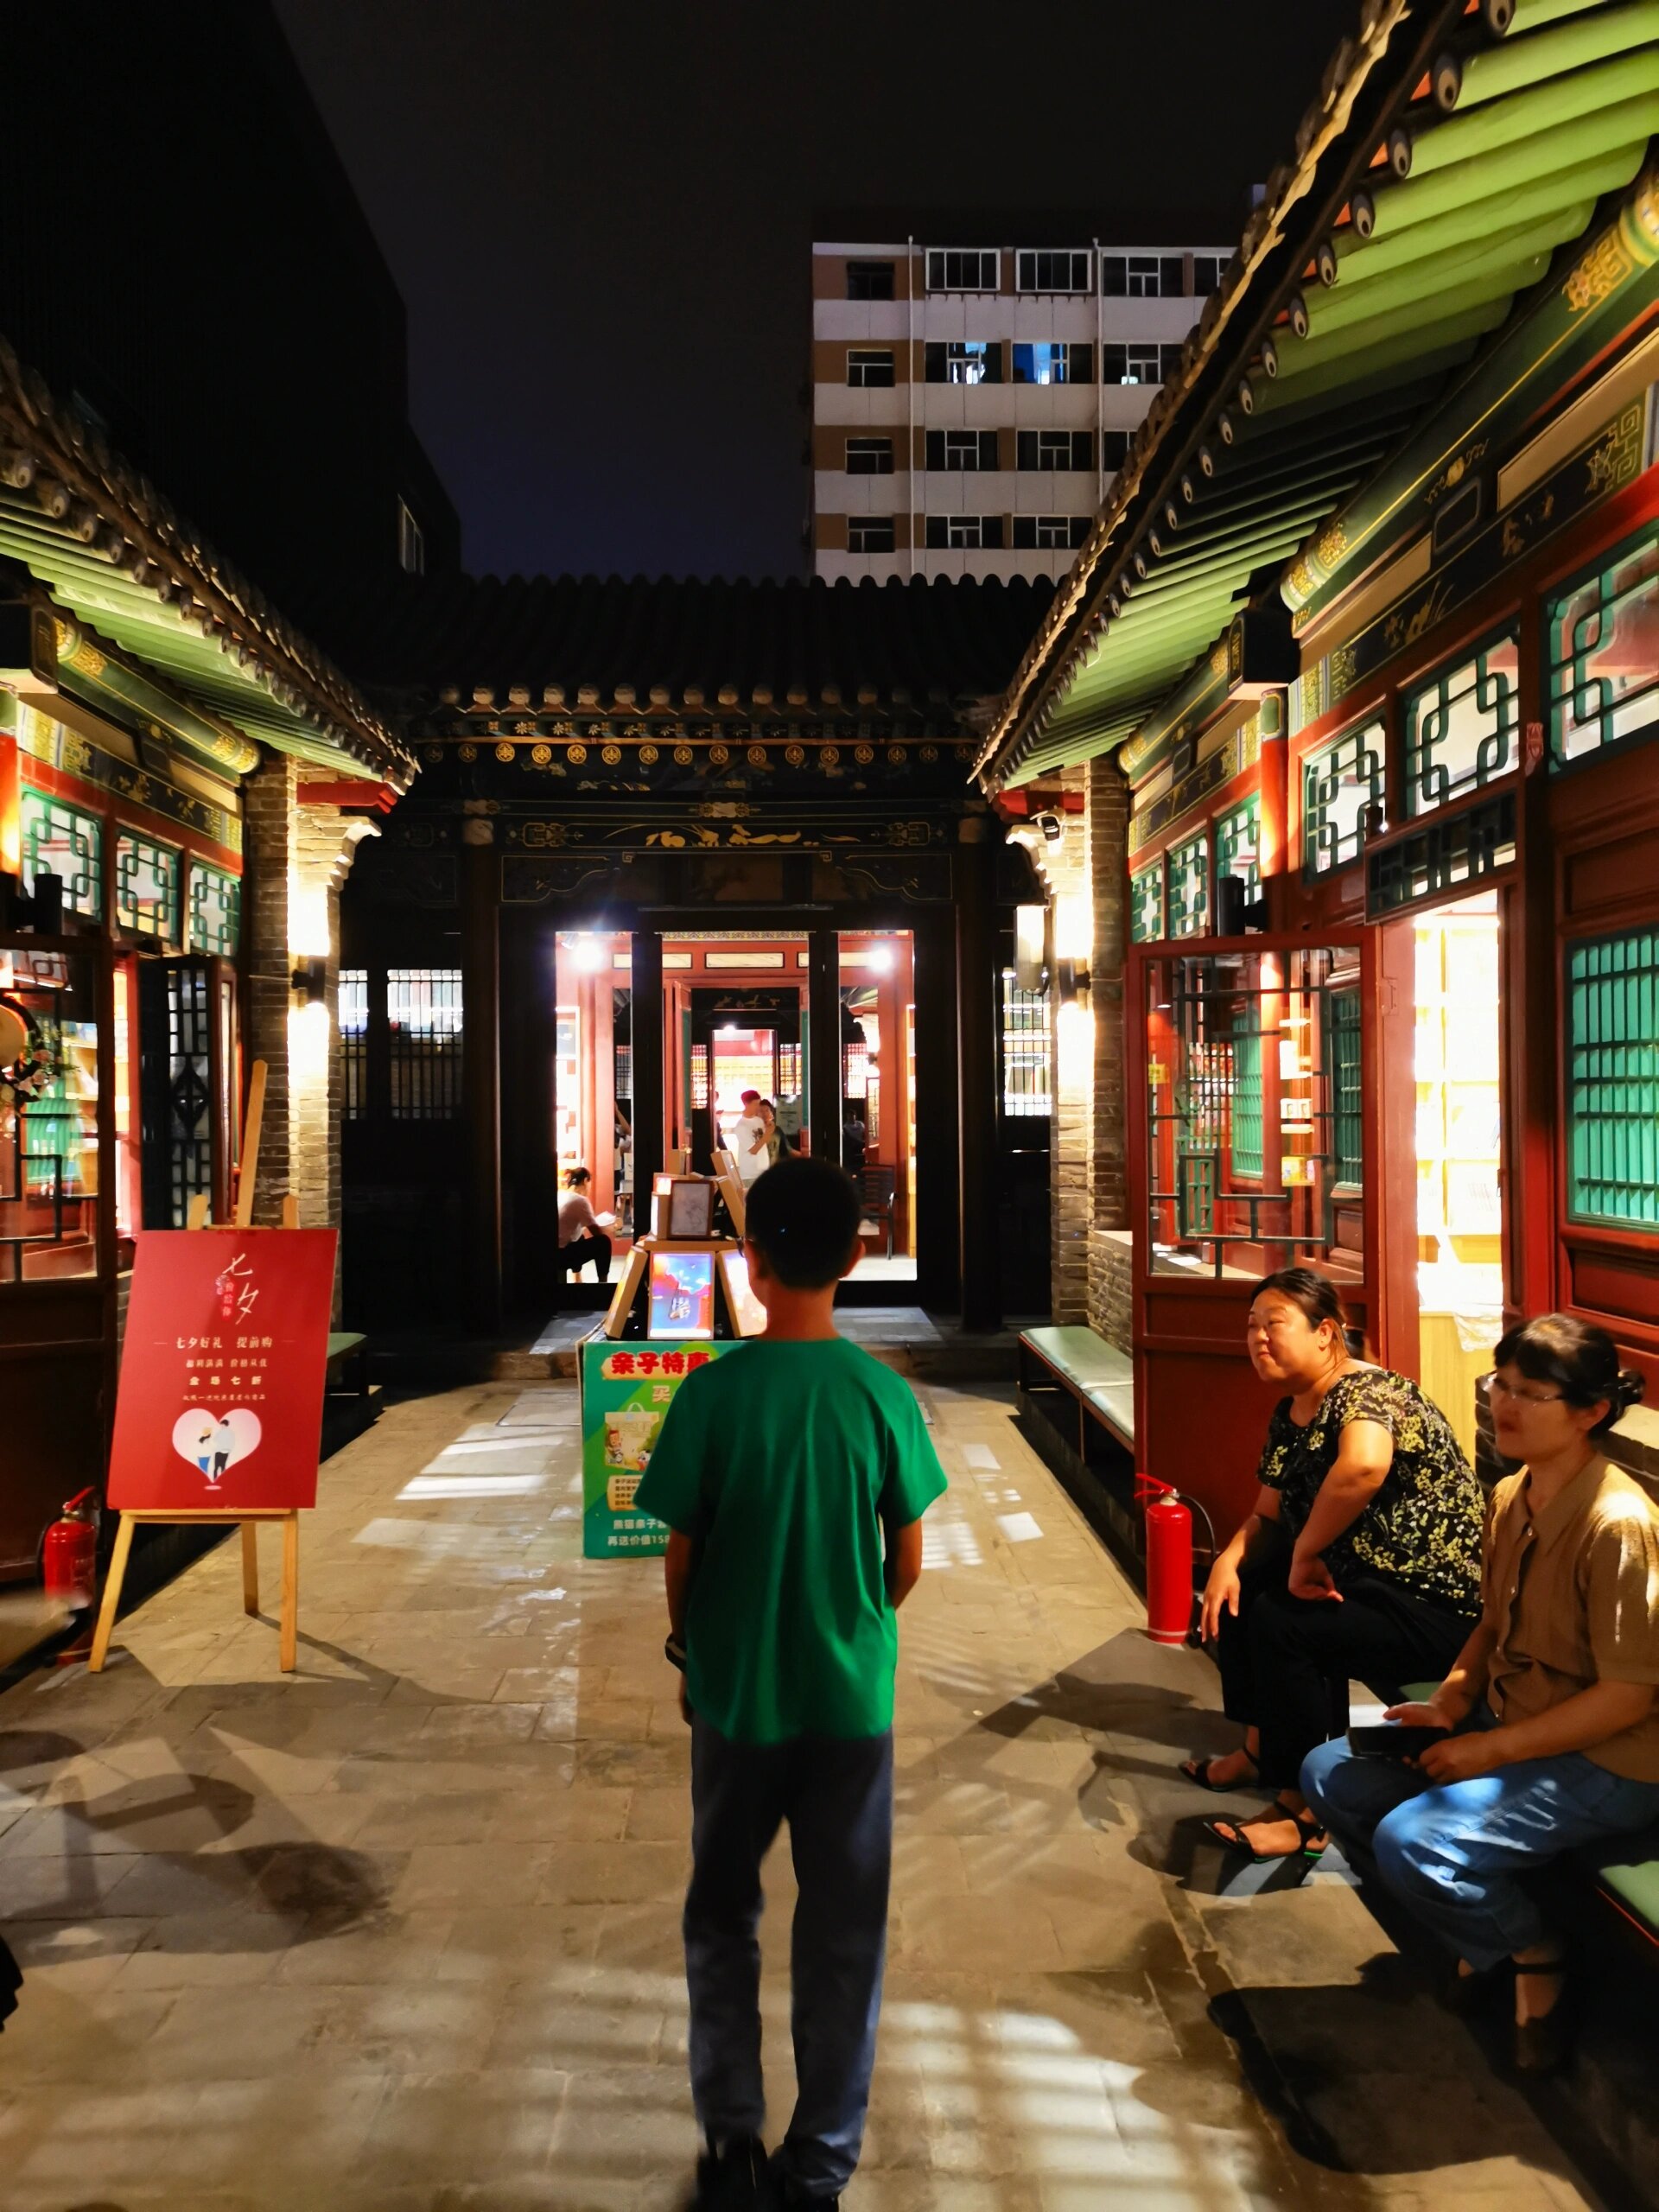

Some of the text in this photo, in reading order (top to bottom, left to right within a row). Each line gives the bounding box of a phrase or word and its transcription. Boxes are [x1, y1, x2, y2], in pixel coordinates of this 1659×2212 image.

[222, 1253, 259, 1325] 七夕
[176, 1336, 273, 1349] 七夕好礼 提前购
